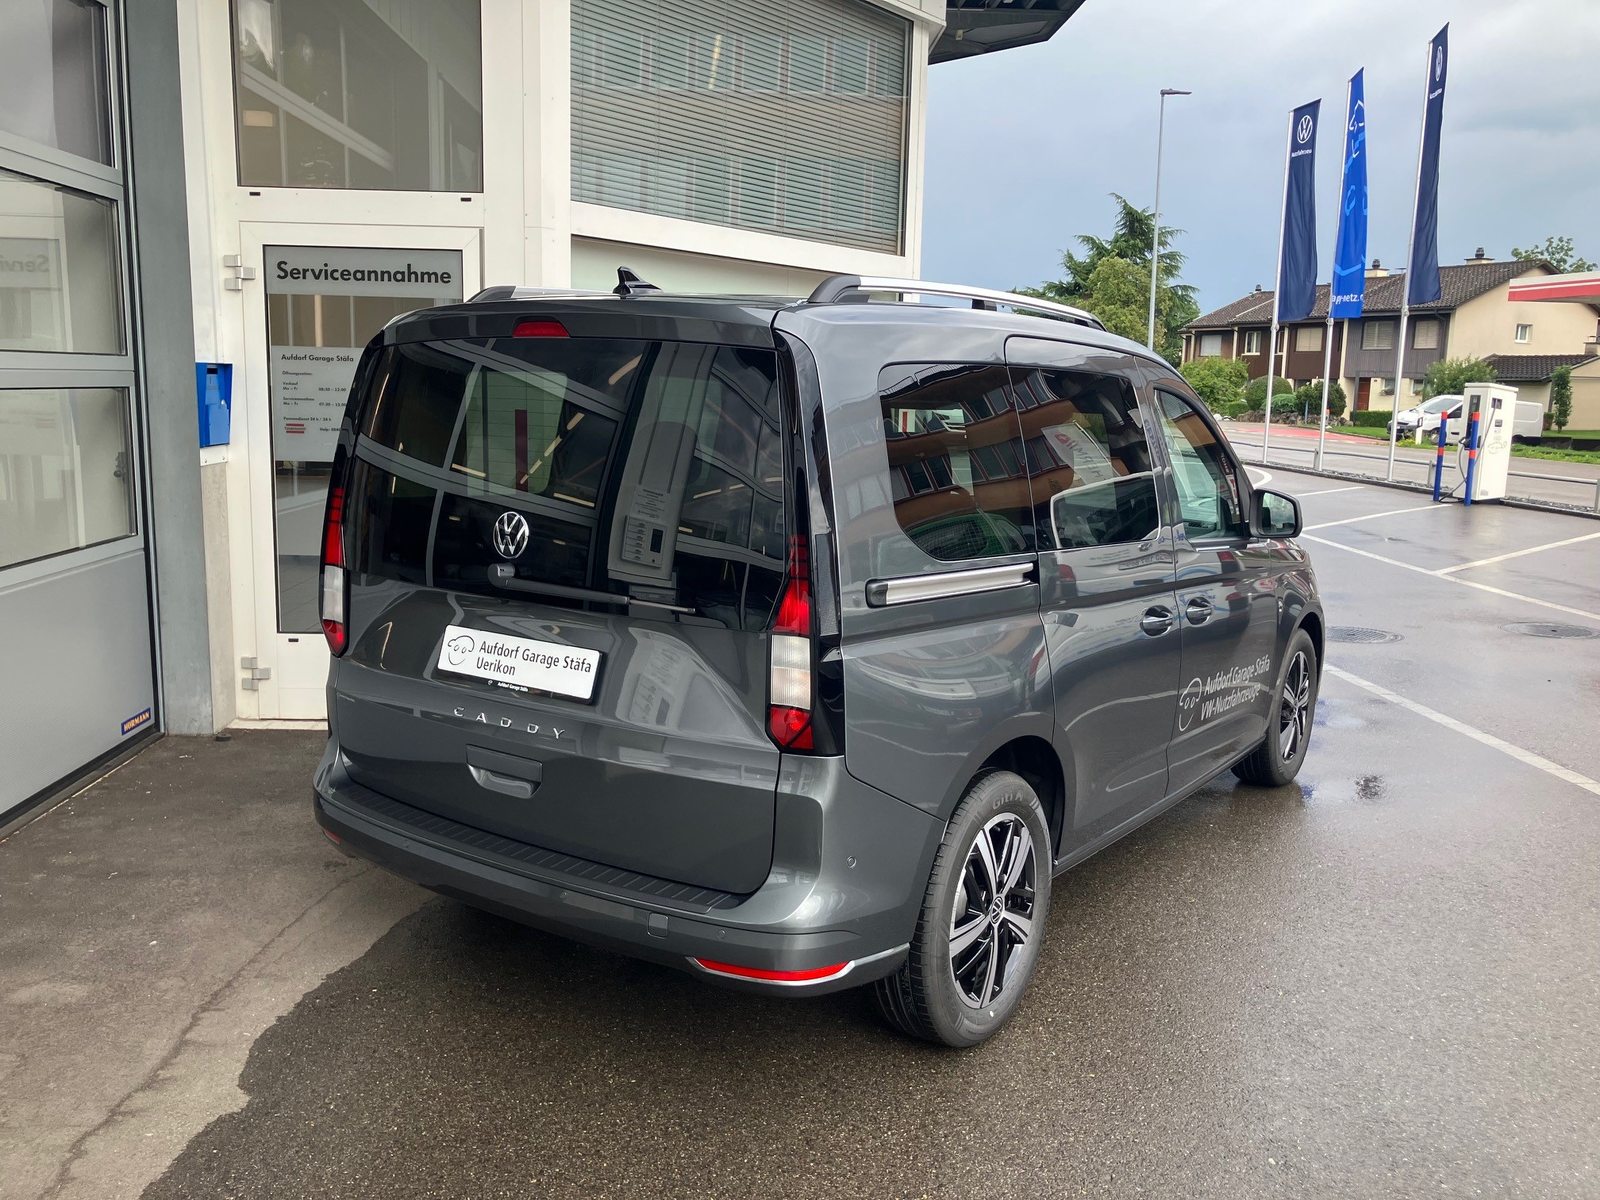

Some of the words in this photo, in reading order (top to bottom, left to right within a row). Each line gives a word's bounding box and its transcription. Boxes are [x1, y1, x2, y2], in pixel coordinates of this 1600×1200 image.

[276, 260, 452, 284] Serviceannahme
[493, 511, 530, 559] VW
[476, 656, 516, 677] Uerikon
[479, 640, 521, 659] Aufdorf
[521, 647, 560, 669] Garage
[563, 655, 592, 674] Stäfa
[1204, 667, 1233, 696] Aufdorf
[1232, 664, 1255, 682] Garage
[1255, 654, 1270, 676] Stäfa
[1201, 684, 1261, 720] VW-Nutzfahrzeuge
[453, 705, 566, 740] CADDY
